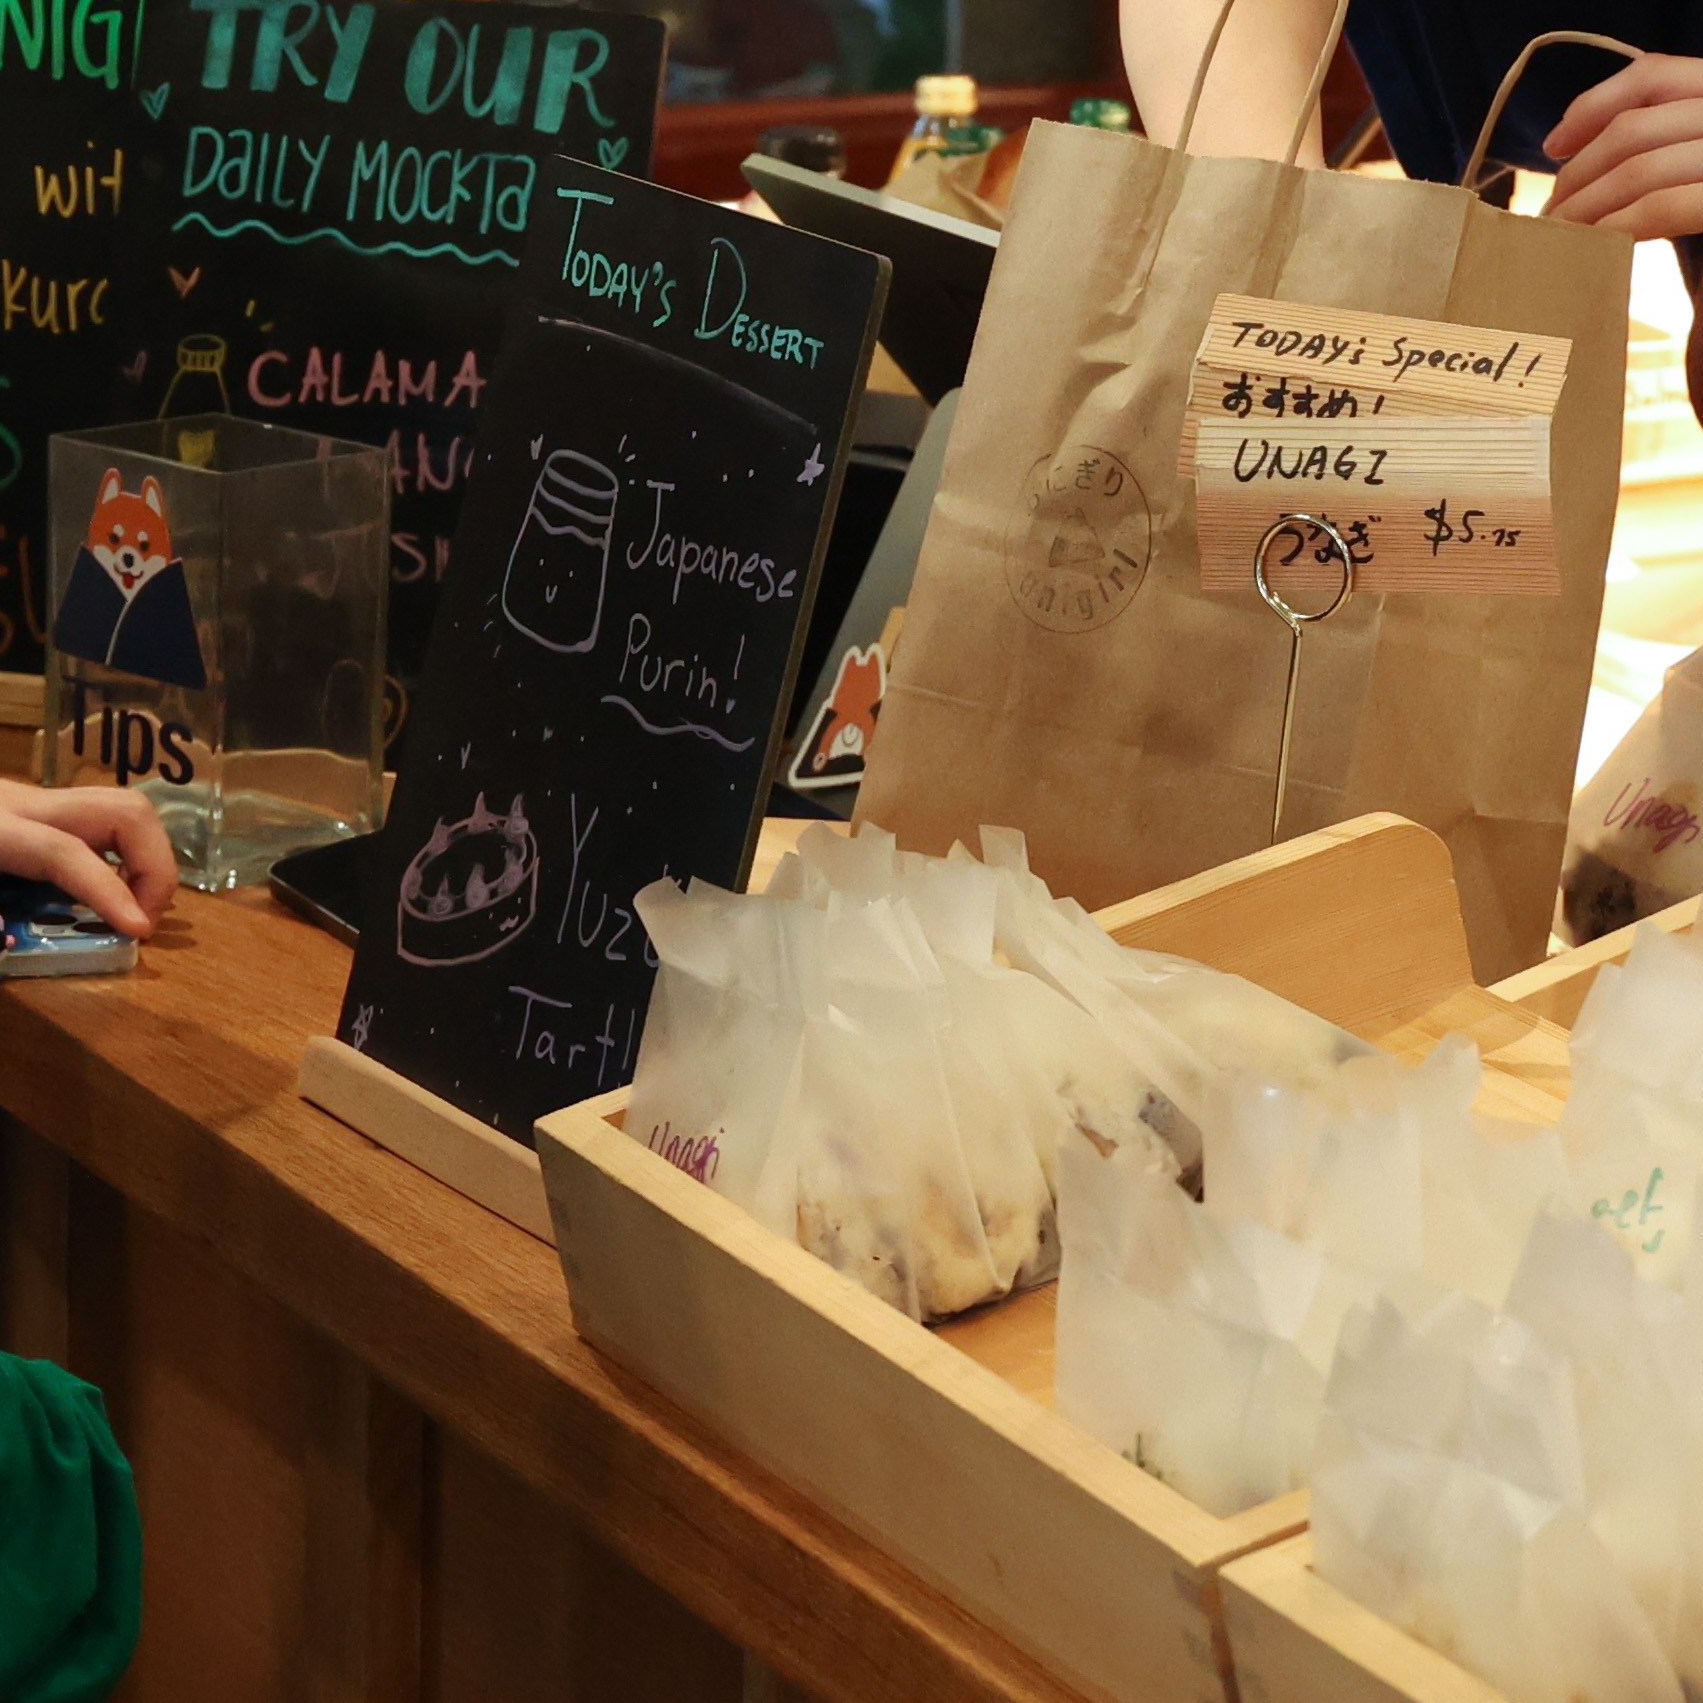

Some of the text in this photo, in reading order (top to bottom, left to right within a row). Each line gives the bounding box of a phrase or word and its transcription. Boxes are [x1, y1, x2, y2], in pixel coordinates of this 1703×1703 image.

[403, 16, 616, 134] OUR
[1232, 437, 1389, 486] UNAGI
[626, 478, 798, 606] Japanese
[62, 675, 194, 787] Tips
